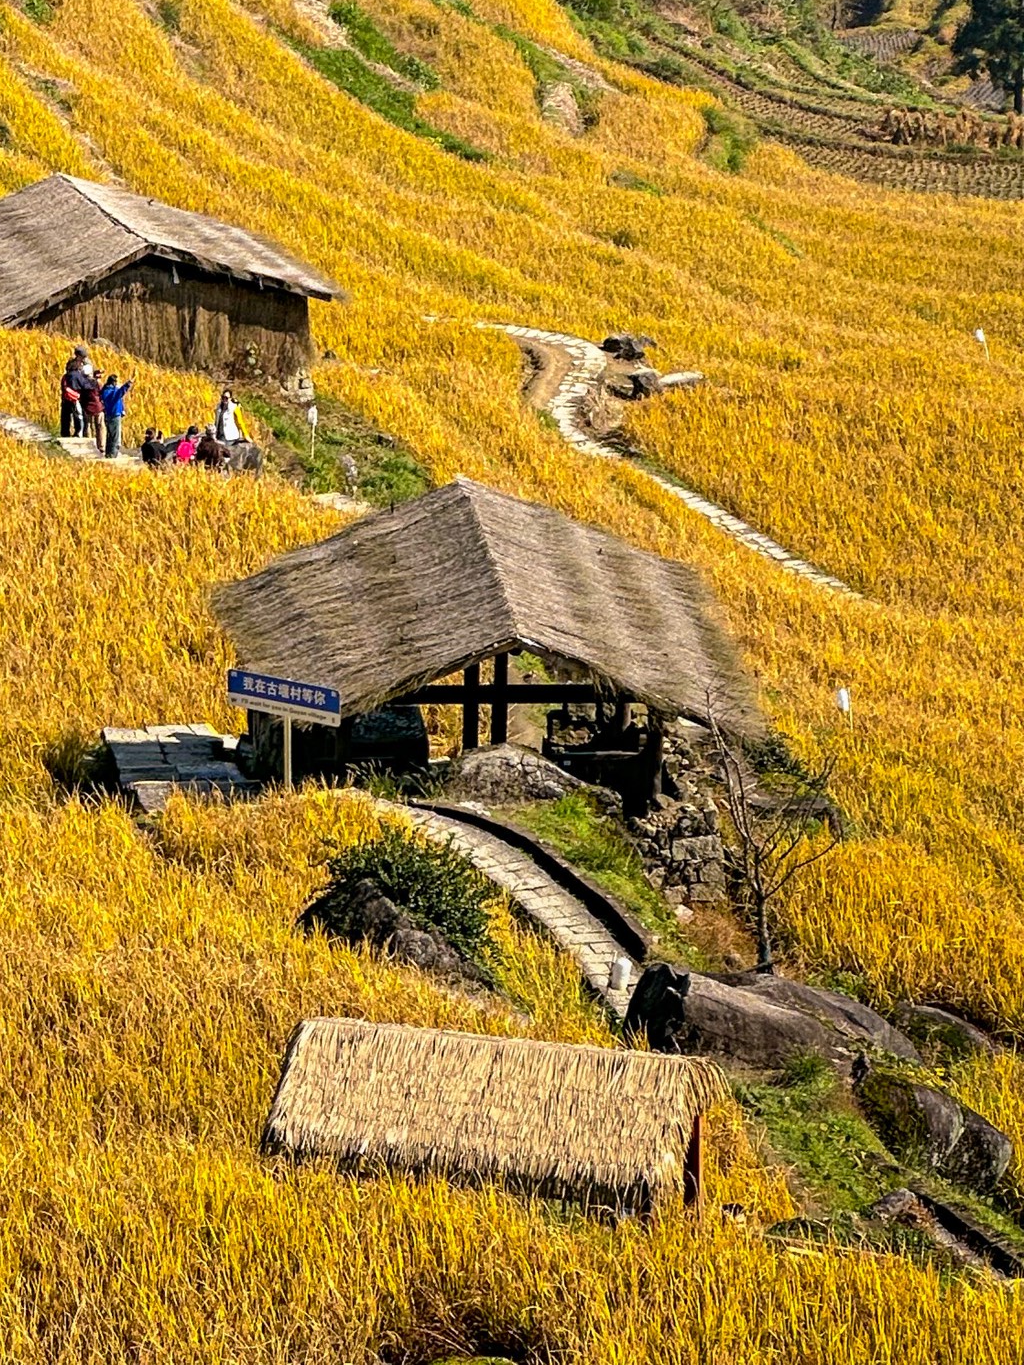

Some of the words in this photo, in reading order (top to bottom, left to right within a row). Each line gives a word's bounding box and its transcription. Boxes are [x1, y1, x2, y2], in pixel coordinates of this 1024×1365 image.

[243, 676, 326, 705] 我在古堰村等你
